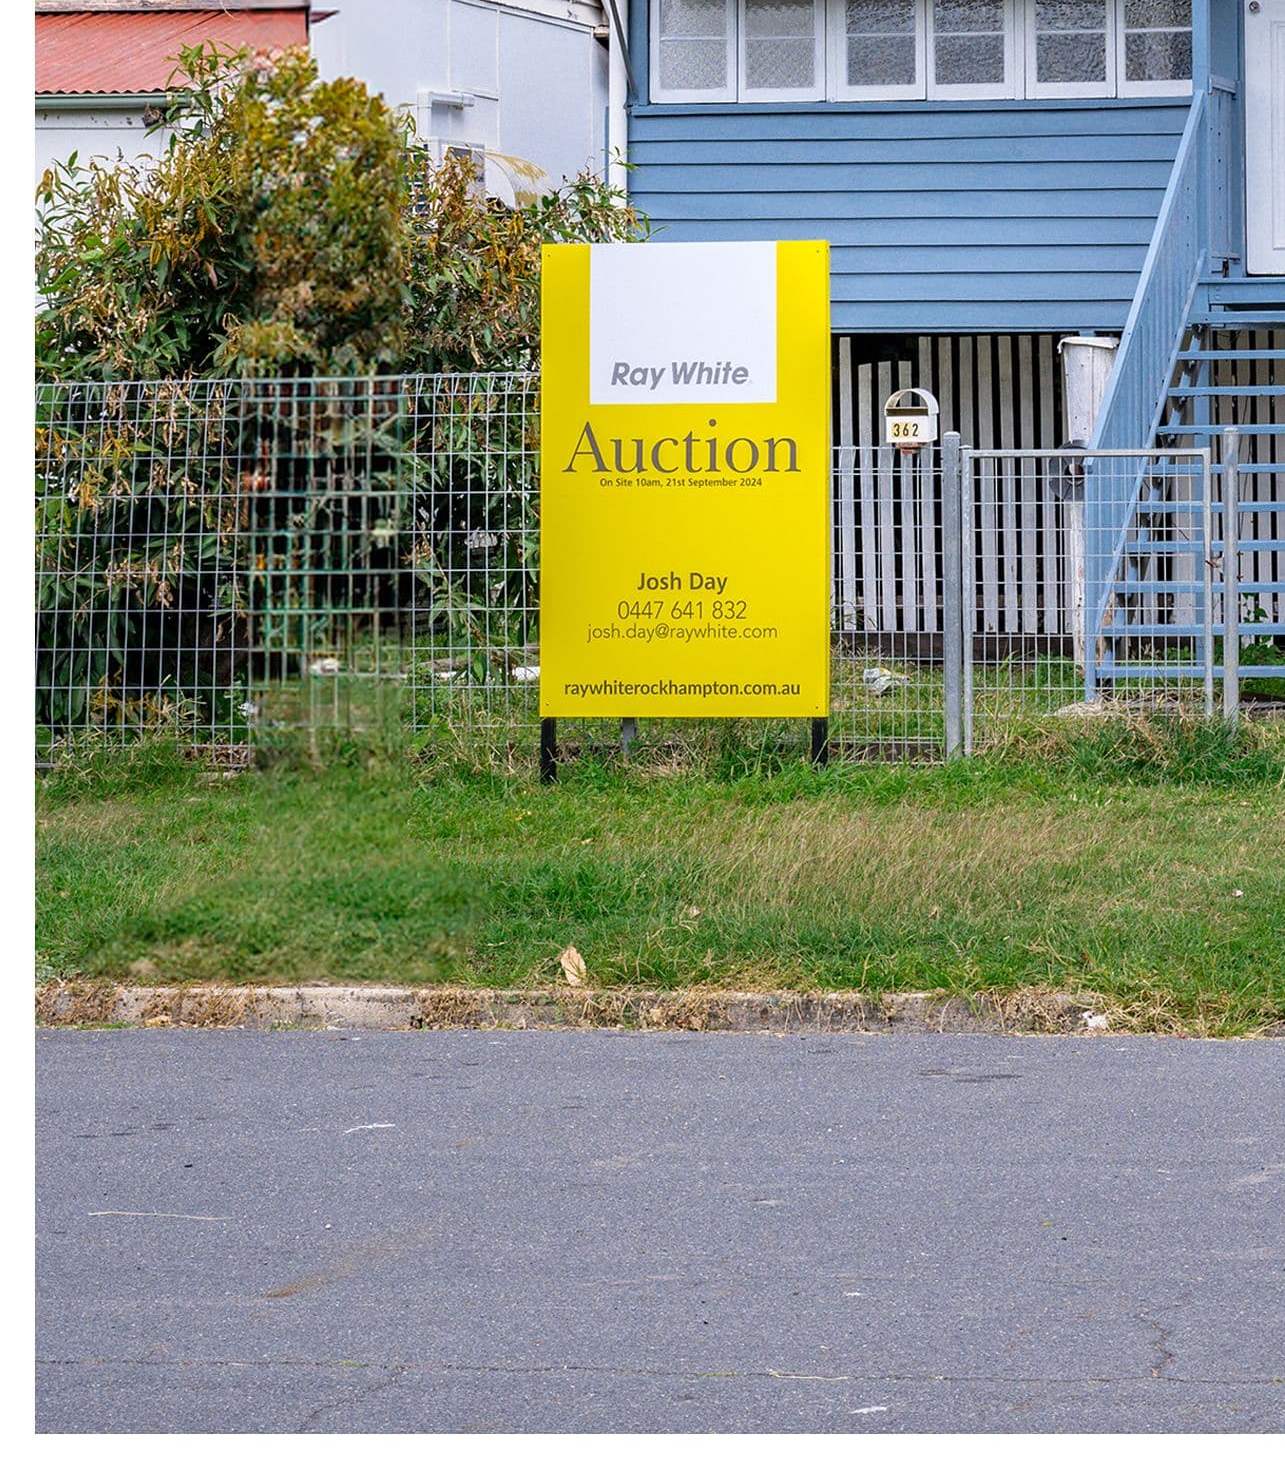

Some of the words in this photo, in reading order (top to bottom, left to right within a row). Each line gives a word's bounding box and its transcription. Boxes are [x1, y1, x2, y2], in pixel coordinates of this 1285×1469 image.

[611, 362, 665, 390] Ray
[672, 361, 749, 385] White
[893, 423, 919, 437] 362
[562, 418, 801, 473] Auction
[600, 478, 613, 488] On
[616, 477, 633, 488] Site
[636, 478, 663, 488] 10am,
[666, 478, 685, 488] 21st
[688, 477, 737, 489] September
[740, 478, 763, 488] 2024
[637, 571, 682, 591] Josh
[690, 572, 728, 595] Day
[618, 600, 664, 620] 0447
[671, 600, 703, 620] 641
[712, 600, 748, 620] 832
[586, 623, 778, 643] josh.day@raywhite.com
[564, 680, 801, 698] raywhiterockhampton.com.au
